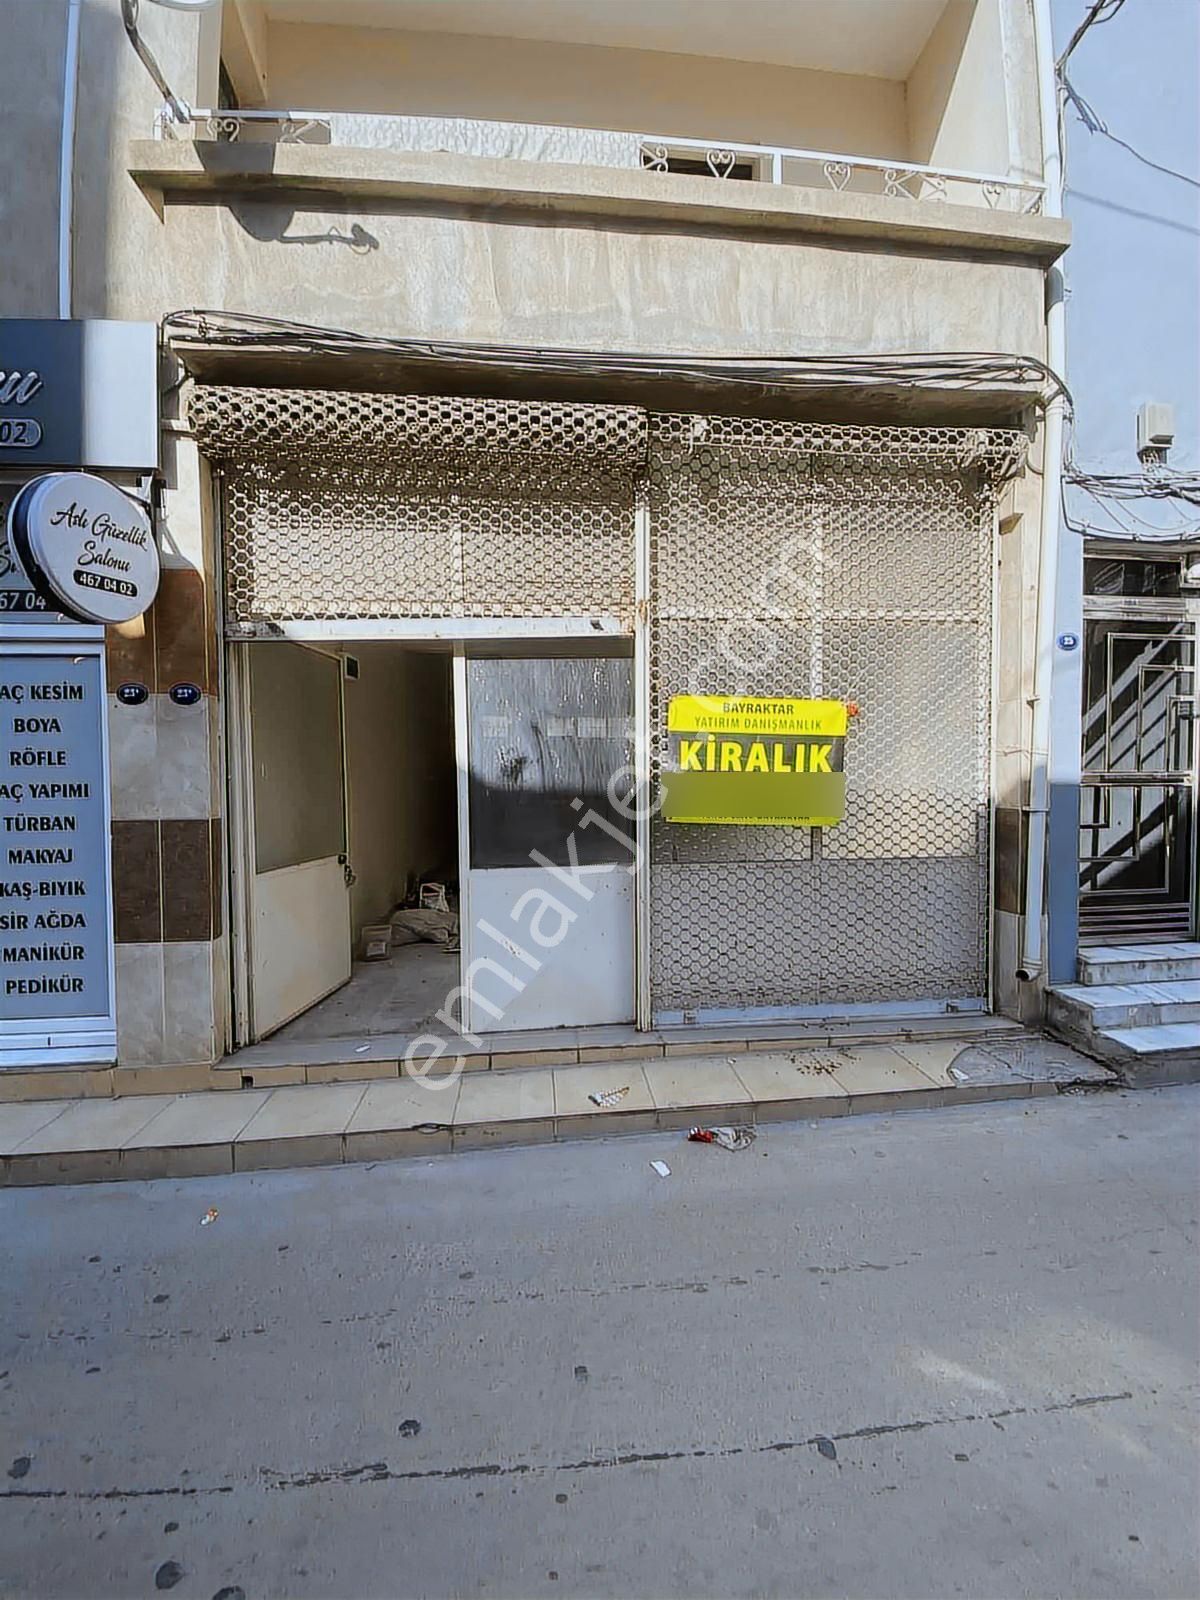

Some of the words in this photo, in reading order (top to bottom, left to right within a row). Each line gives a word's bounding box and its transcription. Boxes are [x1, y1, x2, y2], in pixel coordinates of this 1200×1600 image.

[91, 513, 147, 552] Güzellik
[77, 540, 131, 572] Salonu
[80, 573, 101, 587] 467
[104, 578, 117, 592] 04
[120, 582, 133, 595] 02
[30, 681, 83, 700] KESİM
[723, 703, 794, 715] BAYRAKTAR
[14, 718, 61, 733] BOYA
[694, 716, 740, 729] YATIRIM
[744, 717, 822, 732] DANIŞMANLIK
[10, 747, 66, 766] RÖFLE
[679, 734, 833, 773] KİRALIK
[29, 783, 89, 798] YAPIMI
[3, 812, 76, 832] TÜRBAN
[8, 848, 73, 864] MAKYAJ
[0, 881, 86, 901] KAŞ-BIYIK
[34, 910, 87, 929] AĞDA
[3, 942, 85, 963] MANİKÜR
[6, 974, 84, 994] PEDİKÜR
